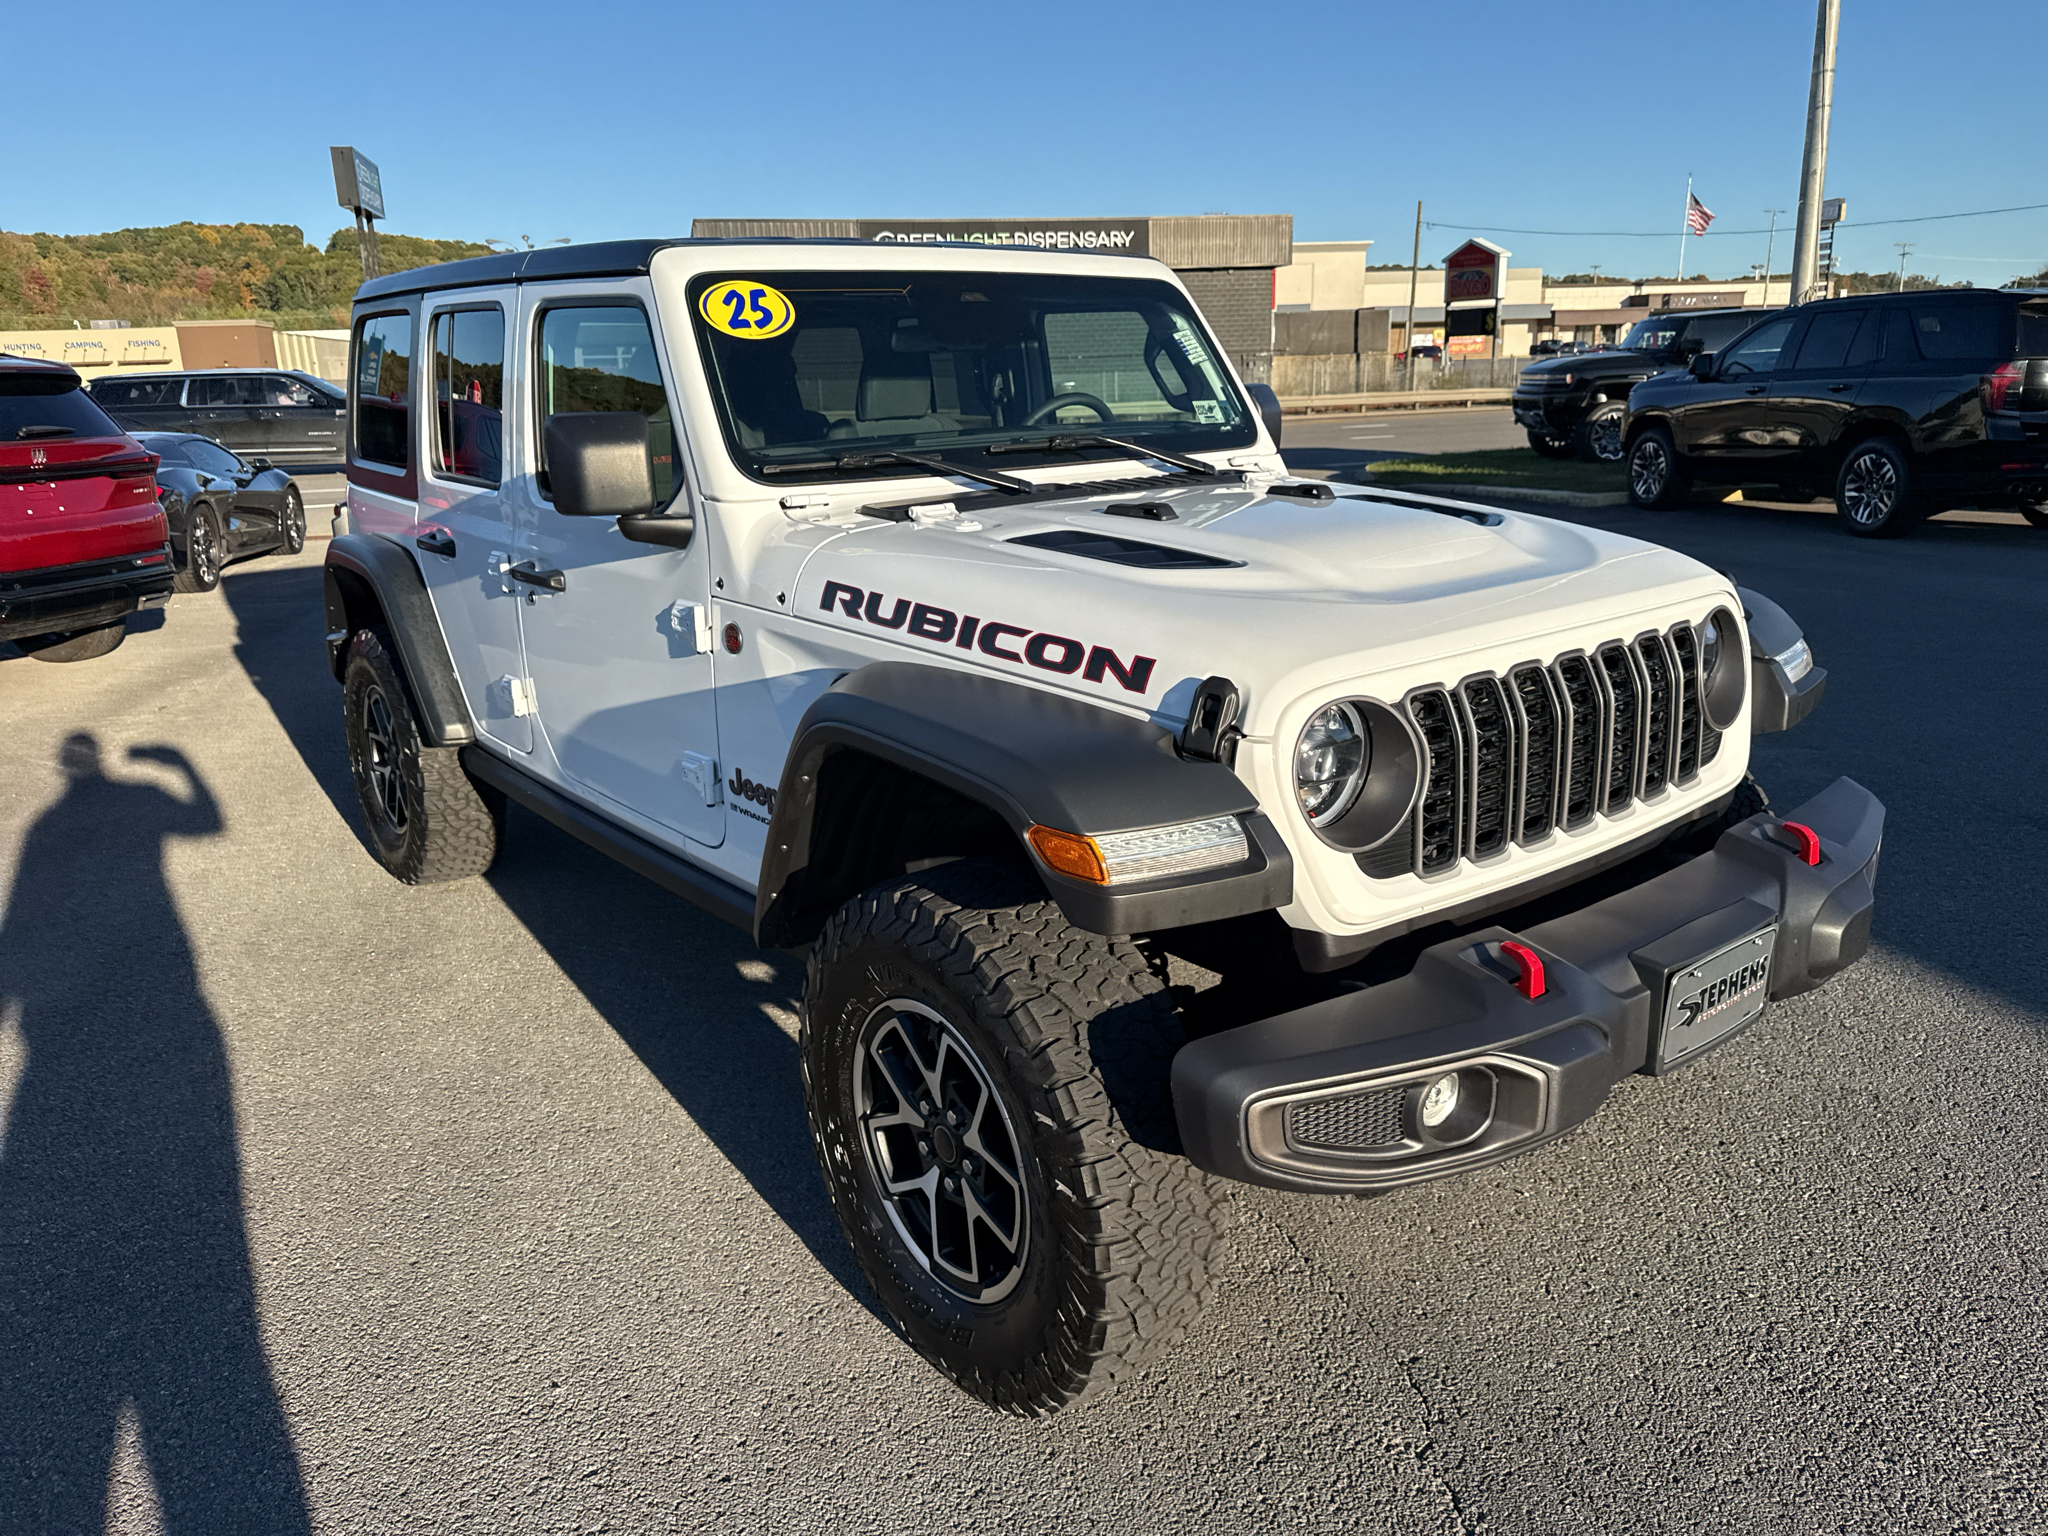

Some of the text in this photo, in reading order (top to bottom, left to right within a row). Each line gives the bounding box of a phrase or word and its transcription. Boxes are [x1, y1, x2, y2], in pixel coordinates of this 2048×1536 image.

[1014, 230, 1135, 249] DISPENSARY
[722, 288, 773, 330] 25
[3, 343, 42, 351] HUNTING
[64, 341, 104, 349] CAMPING
[819, 580, 1157, 694] RUBICON
[728, 767, 778, 815] Jeep
[738, 806, 772, 826] WRANG
[1671, 953, 1769, 1029] STEPHENS
